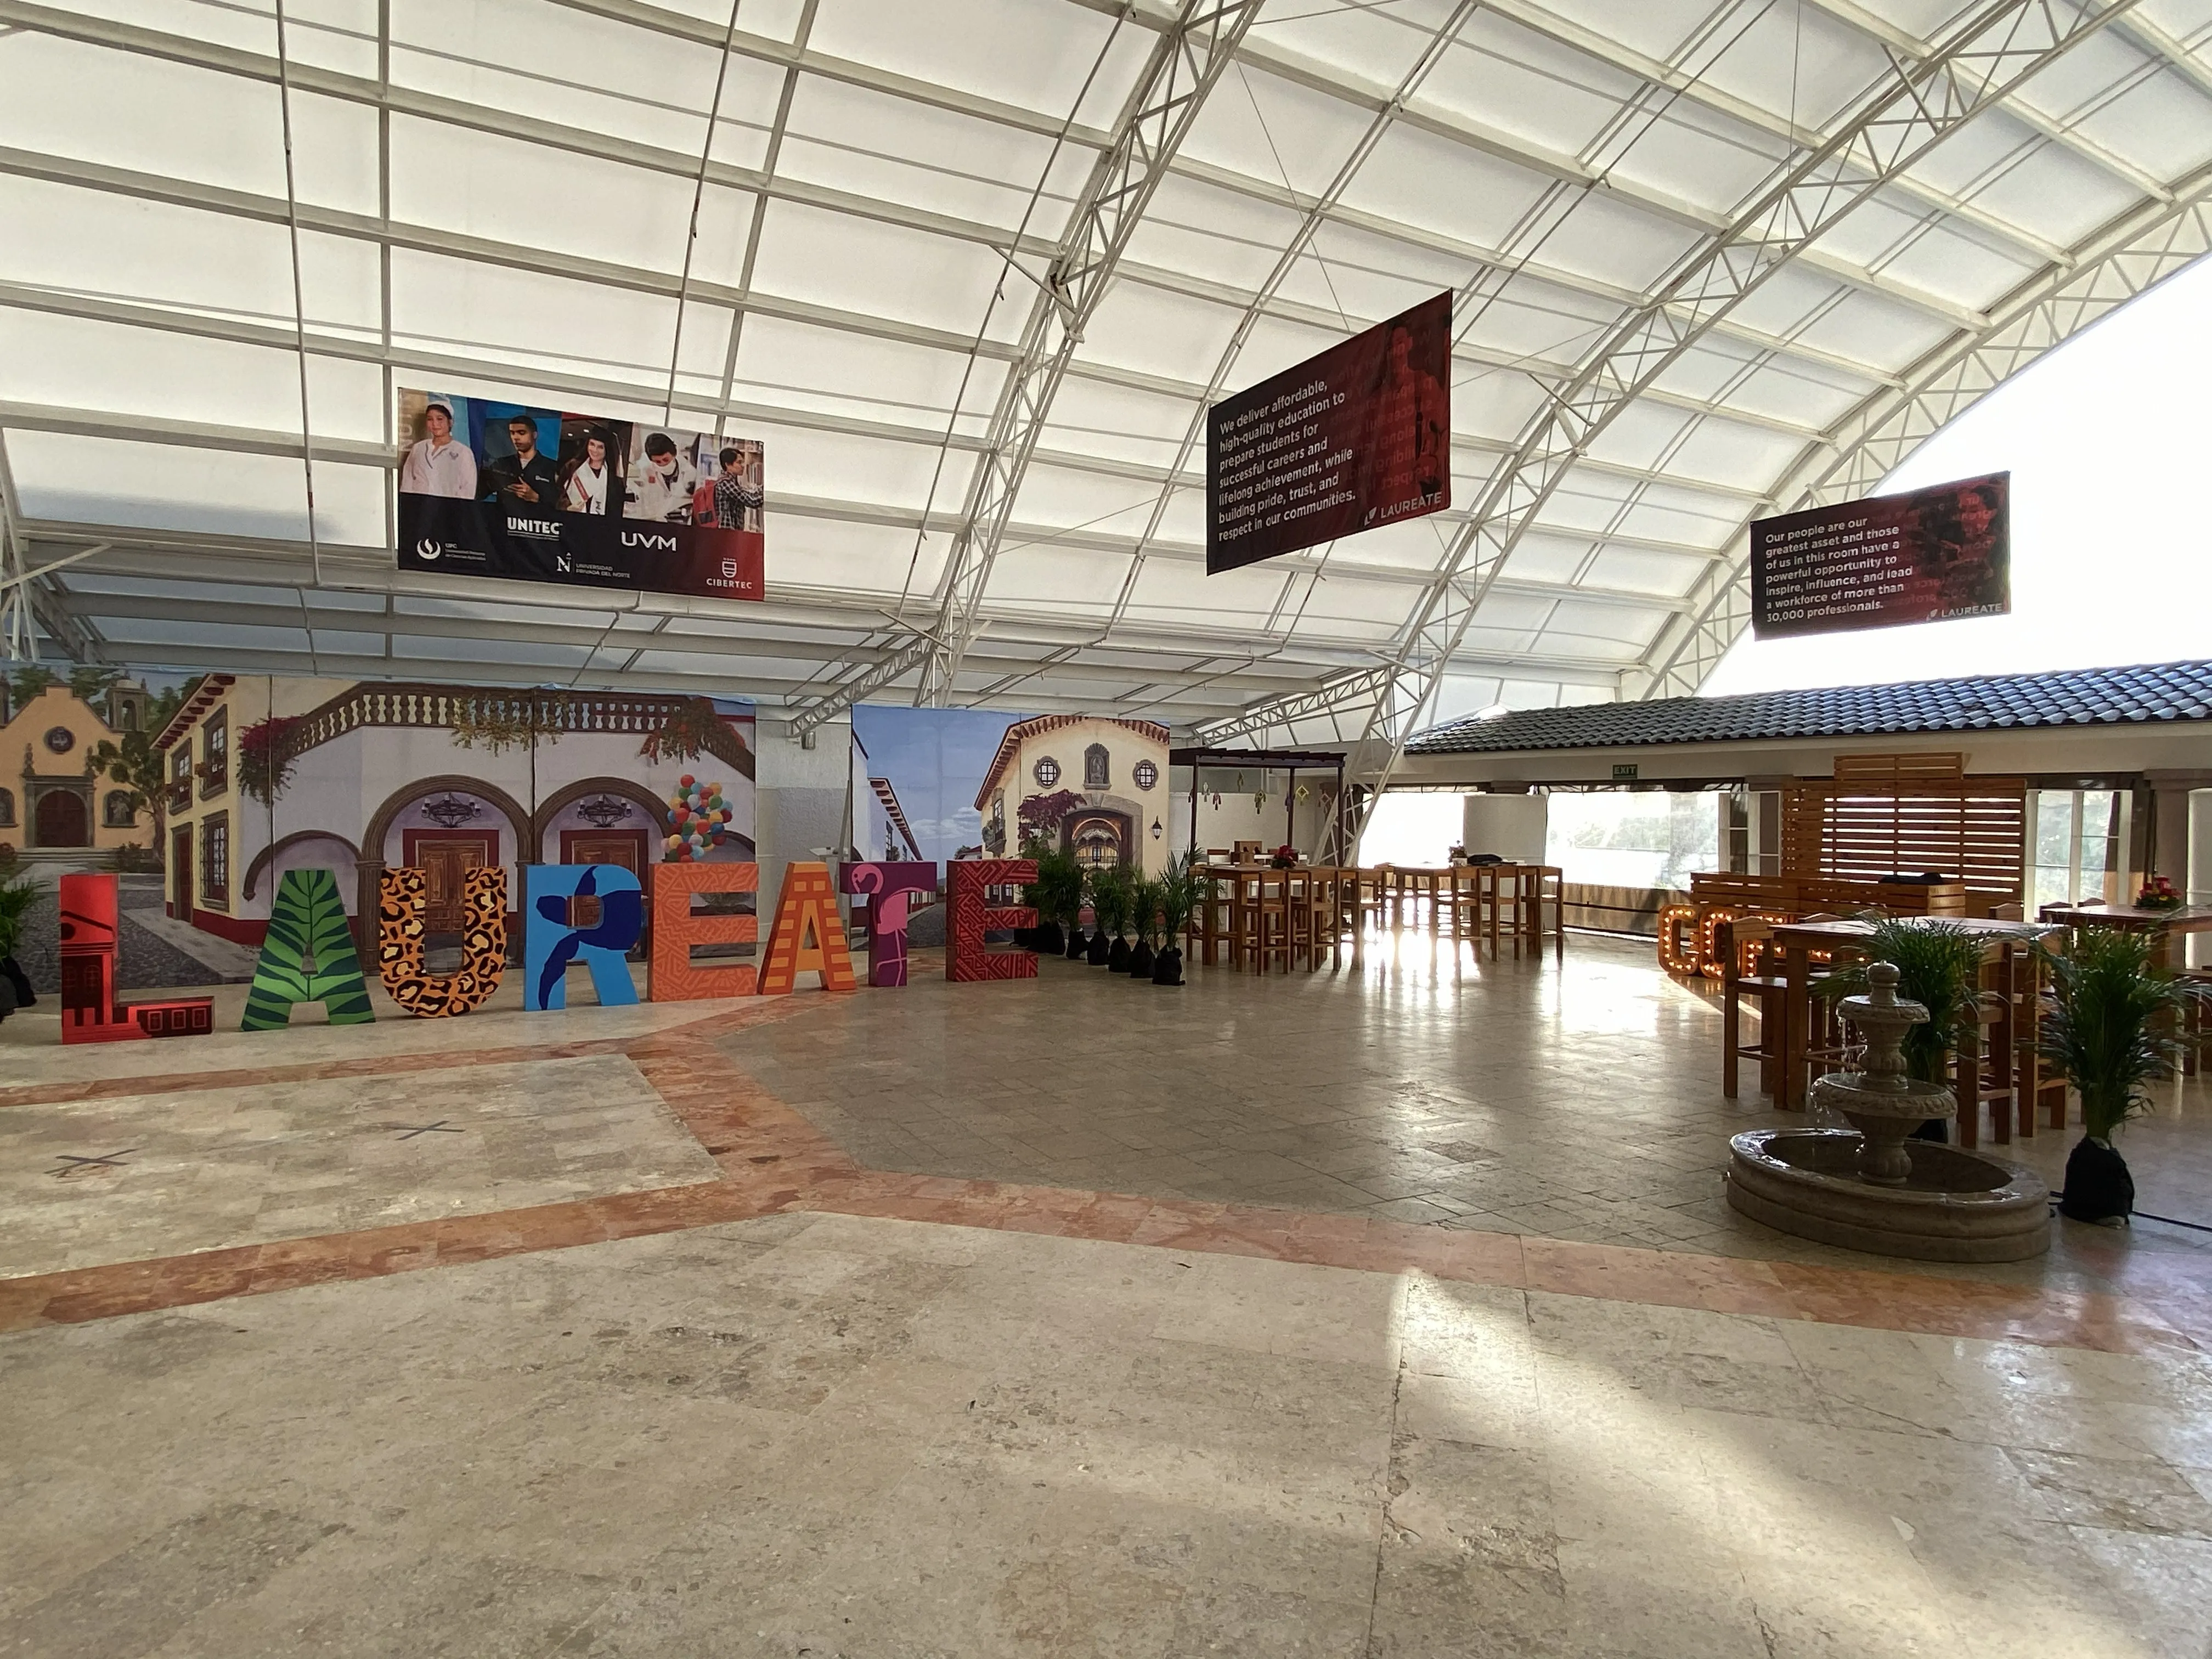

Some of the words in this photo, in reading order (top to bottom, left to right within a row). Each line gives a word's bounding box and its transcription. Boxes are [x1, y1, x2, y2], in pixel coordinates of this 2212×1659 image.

[1220, 420, 1234, 435] We
[1237, 405, 1269, 427] deliver
[1271, 380, 1327, 413] affordable,
[1220, 421, 1275, 453] high-quality
[1277, 398, 1330, 428] education
[1333, 392, 1345, 405] to
[1219, 448, 1255, 473] prepare
[1257, 431, 1300, 455] students
[1303, 423, 1319, 438] for
[1219, 460, 1265, 489] successful
[1267, 448, 1305, 470] careers
[1307, 436, 1328, 456] and
[1218, 486, 1253, 506] lifelong
[1255, 460, 1322, 493] achievement,
[1325, 448, 1353, 469] while
[1218, 503, 1255, 524] building
[1257, 492, 1286, 514] pride,
[1289, 482, 1316, 501] trust,
[1319, 471, 1339, 490] and
[1381, 492, 1442, 518] LAUREATE
[507, 517, 560, 535] UNITEC
[1218, 520, 1252, 541] respect
[1254, 517, 1262, 531] in
[1266, 512, 1281, 527] our
[1284, 490, 1356, 521] communities.
[620, 531, 677, 551] UVM
[1765, 533, 1785, 543] Our
[1787, 524, 1825, 541] people
[1828, 522, 1845, 532] are
[1848, 518, 1868, 528] our
[1765, 541, 1808, 558] greatest
[1812, 535, 1840, 549] asset
[1842, 531, 1863, 544] and
[1866, 527, 1899, 539] those
[1766, 559, 1777, 569] of
[1779, 559, 1791, 568] us
[1794, 555, 1803, 565] in
[1806, 551, 1825, 563] this
[1829, 548, 1858, 560] room
[1861, 543, 1888, 554] have
[1892, 540, 1900, 549] a
[706, 578, 753, 589] CIBERTEC
[1765, 567, 1811, 585] powerful
[1814, 558, 1882, 576] opportunity
[1885, 556, 1897, 565] to
[1766, 583, 1803, 596] inspire,
[1805, 576, 1860, 590] influence,
[1863, 570, 1884, 583] and
[1887, 566, 1913, 579] lead
[1775, 594, 1828, 608] workforce
[1831, 589, 1842, 600] of
[1844, 588, 1875, 599] more
[1878, 583, 1904, 594] than
[1767, 609, 1804, 623] 30,000
[1807, 599, 1884, 619] professionals.
[1941, 603, 2002, 618] LAUREATE
[1614, 766, 1636, 774] EXIT
